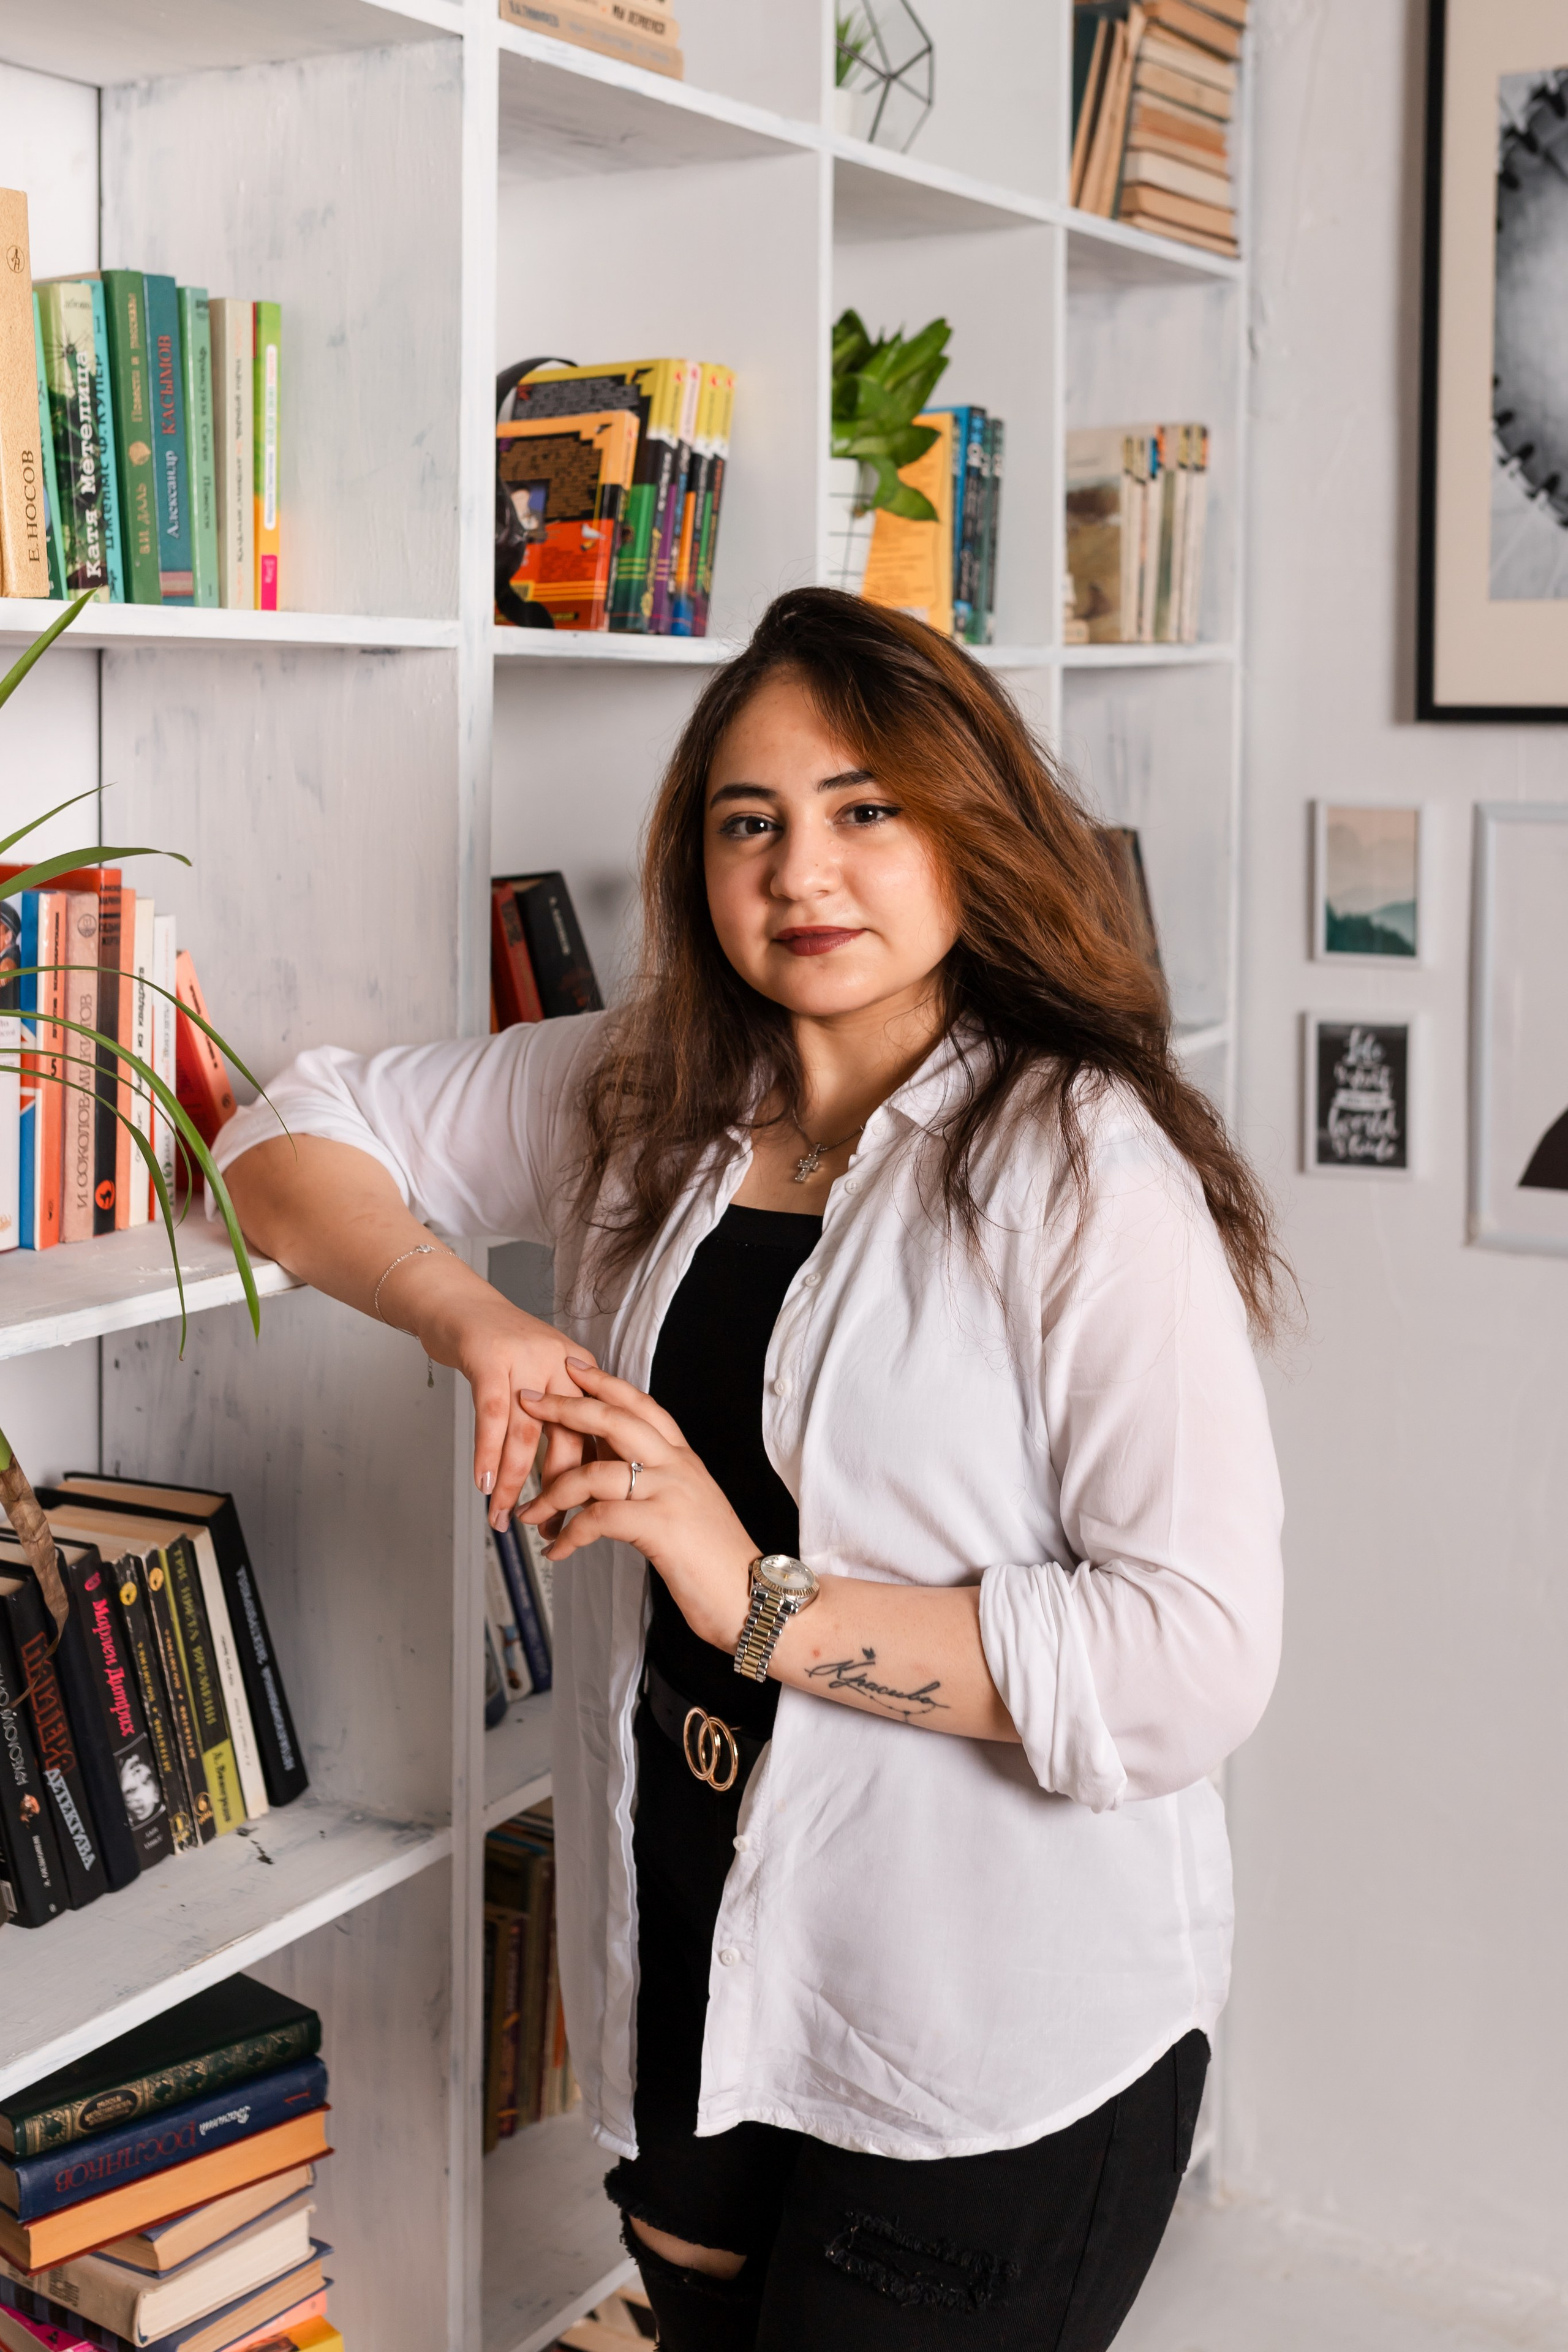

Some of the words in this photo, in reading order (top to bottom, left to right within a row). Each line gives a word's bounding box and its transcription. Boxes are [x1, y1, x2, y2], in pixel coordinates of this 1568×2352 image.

[157, 335, 176, 434] КАСЫМОВ
[75, 350, 96, 494] Метелица
[165, 450, 180, 539] Александр
[85, 509, 102, 578] Катя
[92, 1597, 118, 1666] Марлен
[104, 1666, 135, 1738] Дитрих
[805, 1659, 951, 1709] Красиво
[55, 2120, 196, 2193] РОСЛЯКОВ
[199, 2105, 251, 2136] Василий
